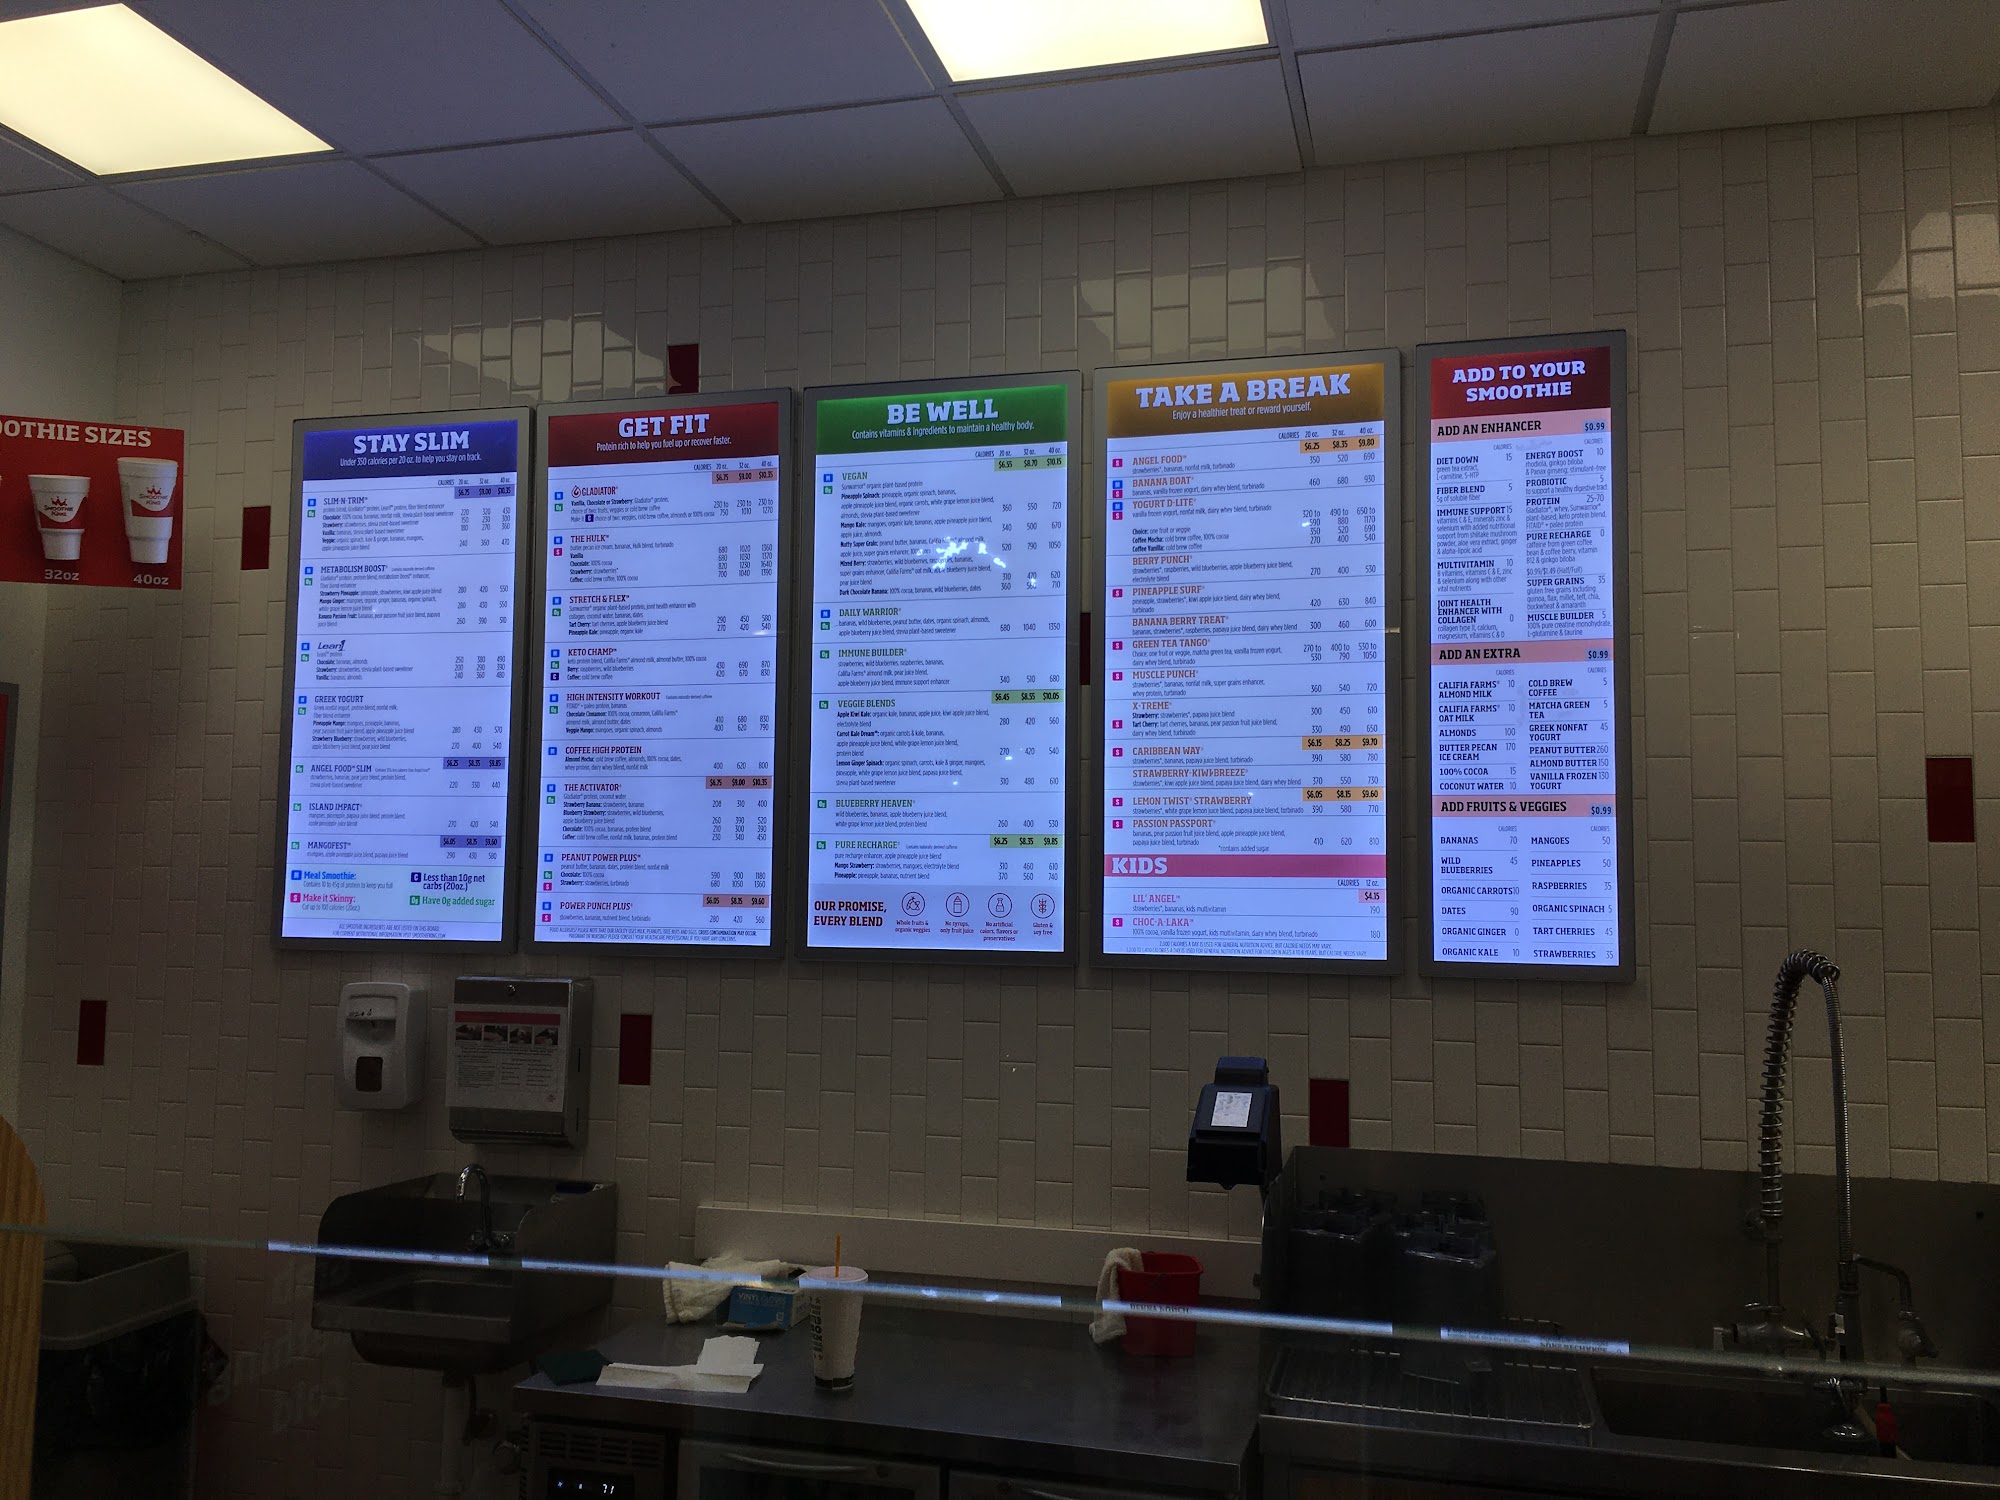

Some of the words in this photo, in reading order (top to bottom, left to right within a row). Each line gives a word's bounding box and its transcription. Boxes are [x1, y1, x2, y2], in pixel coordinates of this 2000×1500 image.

[1453, 367, 1495, 383] ADD
[1499, 365, 1525, 380] TO
[1530, 360, 1585, 378] YOUR
[1136, 384, 1212, 408] TAKE
[1219, 382, 1240, 403] A
[1247, 373, 1350, 402] BREAK
[1467, 381, 1572, 402] SMOOTHIE
[888, 403, 920, 424] BE
[927, 399, 998, 422] WELL
[1172, 410, 1191, 421] Enjoy
[1198, 408, 1228, 418] healthier
[1230, 407, 1246, 416] treat
[1248, 407, 1255, 415] or
[1257, 404, 1281, 414] reward
[1282, 401, 1311, 413] yourself.
[619, 417, 665, 437] GET
[670, 414, 709, 434] FIT
[852, 429, 878, 439] Contains
[879, 428, 905, 438] vitamins
[907, 428, 911, 436] &
[912, 426, 948, 437] ingredients
[949, 425, 955, 434] to
[957, 424, 985, 433] maintain
[991, 422, 1015, 432] healthy
[1017, 420, 1034, 431] body.
[1437, 425, 1460, 436] ADD
[1463, 424, 1478, 434] AN
[1481, 420, 1541, 433] ENHANCER
[1585, 422, 1605, 432] $0.99
[0, 420, 79, 442] OTHIE
[85, 427, 151, 447] SIZES
[354, 434, 410, 454] STAY
[415, 431, 469, 451] SLIM
[597, 442, 617, 451] Protein
[618, 441, 628, 450] rich
[630, 442, 636, 450] to
[637, 440, 650, 450] help
[651, 441, 661, 449] you
[663, 439, 674, 448] fuel
[675, 440, 683, 448] up
[691, 438, 712, 446] recover
[714, 436, 731, 444] faster.
[1304, 441, 1320, 451] $6.25
[1332, 439, 1348, 448] $8.35
[1358, 438, 1374, 447] $9.80
[340, 458, 356, 466] Under
[357, 457, 366, 466] 350
[368, 456, 388, 465] calories
[389, 457, 398, 465] per
[422, 455, 434, 463] help
[446, 454, 457, 462] stay
[467, 452, 482, 460] track.
[1309, 455, 1320, 464] 350
[1338, 454, 1348, 462] 520
[1364, 452, 1375, 460] 690
[1526, 451, 1556, 460] ENERGY
[1557, 450, 1583, 458] BOOST
[1437, 457, 1454, 465] DIET
[1455, 456, 1479, 464] DOWN
[842, 472, 868, 481] VEGAN
[1526, 477, 1567, 487] PROBIOTIC
[1460, 486, 1485, 494] BLEND
[1437, 508, 1469, 516] IMMUNE
[1470, 506, 1505, 515] SUPPORT
[1437, 560, 1494, 569] MULTIVITAMIN
[45, 569, 79, 581] 32oz
[133, 574, 168, 585] 40oz
[1439, 649, 1461, 659] ADD
[1465, 649, 1481, 659] AN
[1484, 648, 1520, 658] EXTRA
[1588, 650, 1608, 659] $0.99
[1550, 679, 1573, 687] BREW
[567, 693, 584, 701] HIGH
[586, 693, 623, 701] INTENSITY
[625, 692, 660, 700] WORKOUT
[1529, 689, 1557, 697] COFFEE
[838, 699, 864, 708] VEGGIE
[866, 699, 895, 708] BLENDS
[1307, 738, 1322, 747] $6.15
[1335, 738, 1350, 747] $8.25
[1362, 738, 1377, 746] $9.70
[1564, 746, 1596, 754] BUTTER
[1441, 802, 1463, 812] ADD
[1467, 801, 1506, 812] FRUITS
[1509, 802, 1517, 811] &
[1520, 801, 1567, 812] VEGGIES
[1591, 806, 1611, 814] $0.99
[1112, 857, 1168, 874] KIDS
[1441, 866, 1493, 874] BLUEBERRIES
[303, 872, 321, 880] Meal
[423, 874, 441, 882] Less
[442, 874, 457, 882] than
[459, 874, 472, 884] 10g
[423, 882, 442, 890] carbs
[444, 882, 468, 892] (20oz.)
[1532, 882, 1587, 890] RASPBERRIES
[303, 894, 321, 902] Make
[323, 894, 328, 902] it
[329, 895, 355, 903] Skinny:
[422, 897, 440, 905] Have
[442, 898, 451, 906] 0g
[453, 897, 474, 905] added
[475, 899, 495, 907] sugar
[814, 902, 836, 912] OUR
[838, 902, 887, 913] PROMISE,
[1442, 907, 1466, 915] DATES
[814, 917, 847, 926] EVERY
[849, 917, 883, 926] BLEND
[1533, 927, 1554, 935] TART
[1556, 927, 1595, 935] CHERRIES
[1534, 950, 1596, 958] STRAWBERRIES
